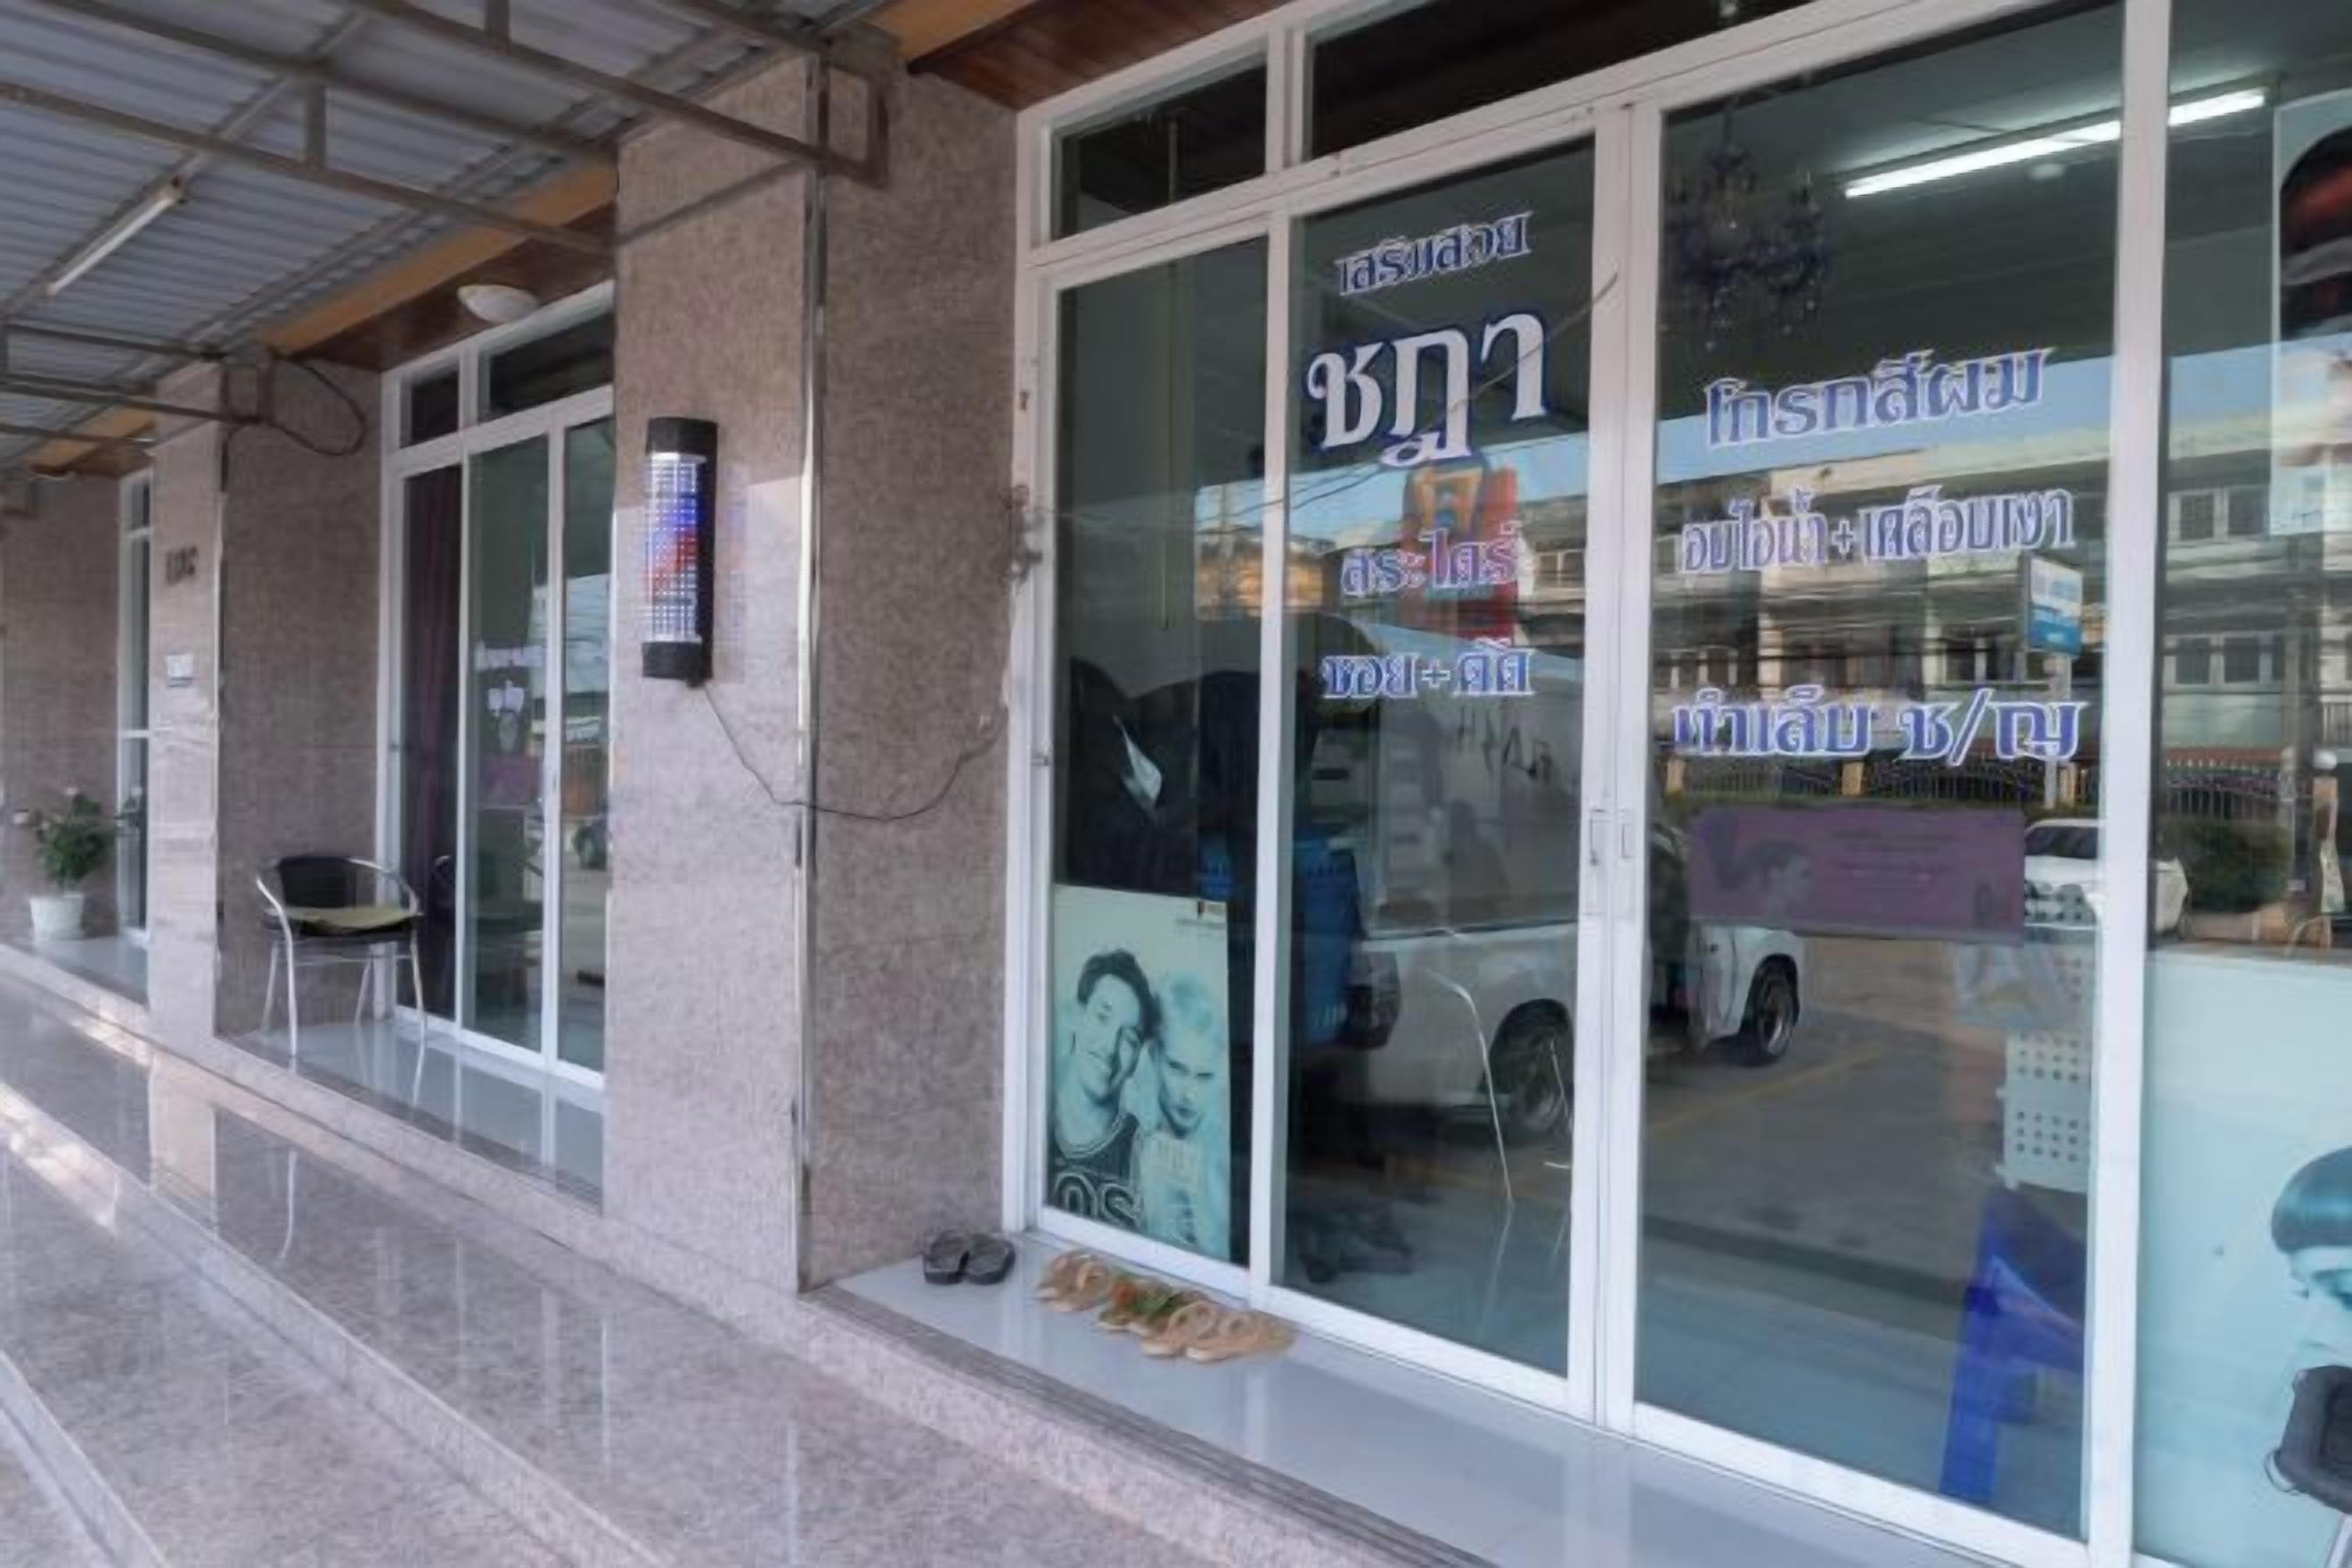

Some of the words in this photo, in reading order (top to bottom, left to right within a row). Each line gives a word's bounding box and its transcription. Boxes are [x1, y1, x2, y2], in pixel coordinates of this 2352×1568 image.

[1335, 210, 1533, 296] เสริมสวย
[1705, 347, 2054, 446] โกรกสีผม
[1672, 684, 1872, 757] ทำเล็บ
[1894, 688, 2087, 767] ช/ญ
